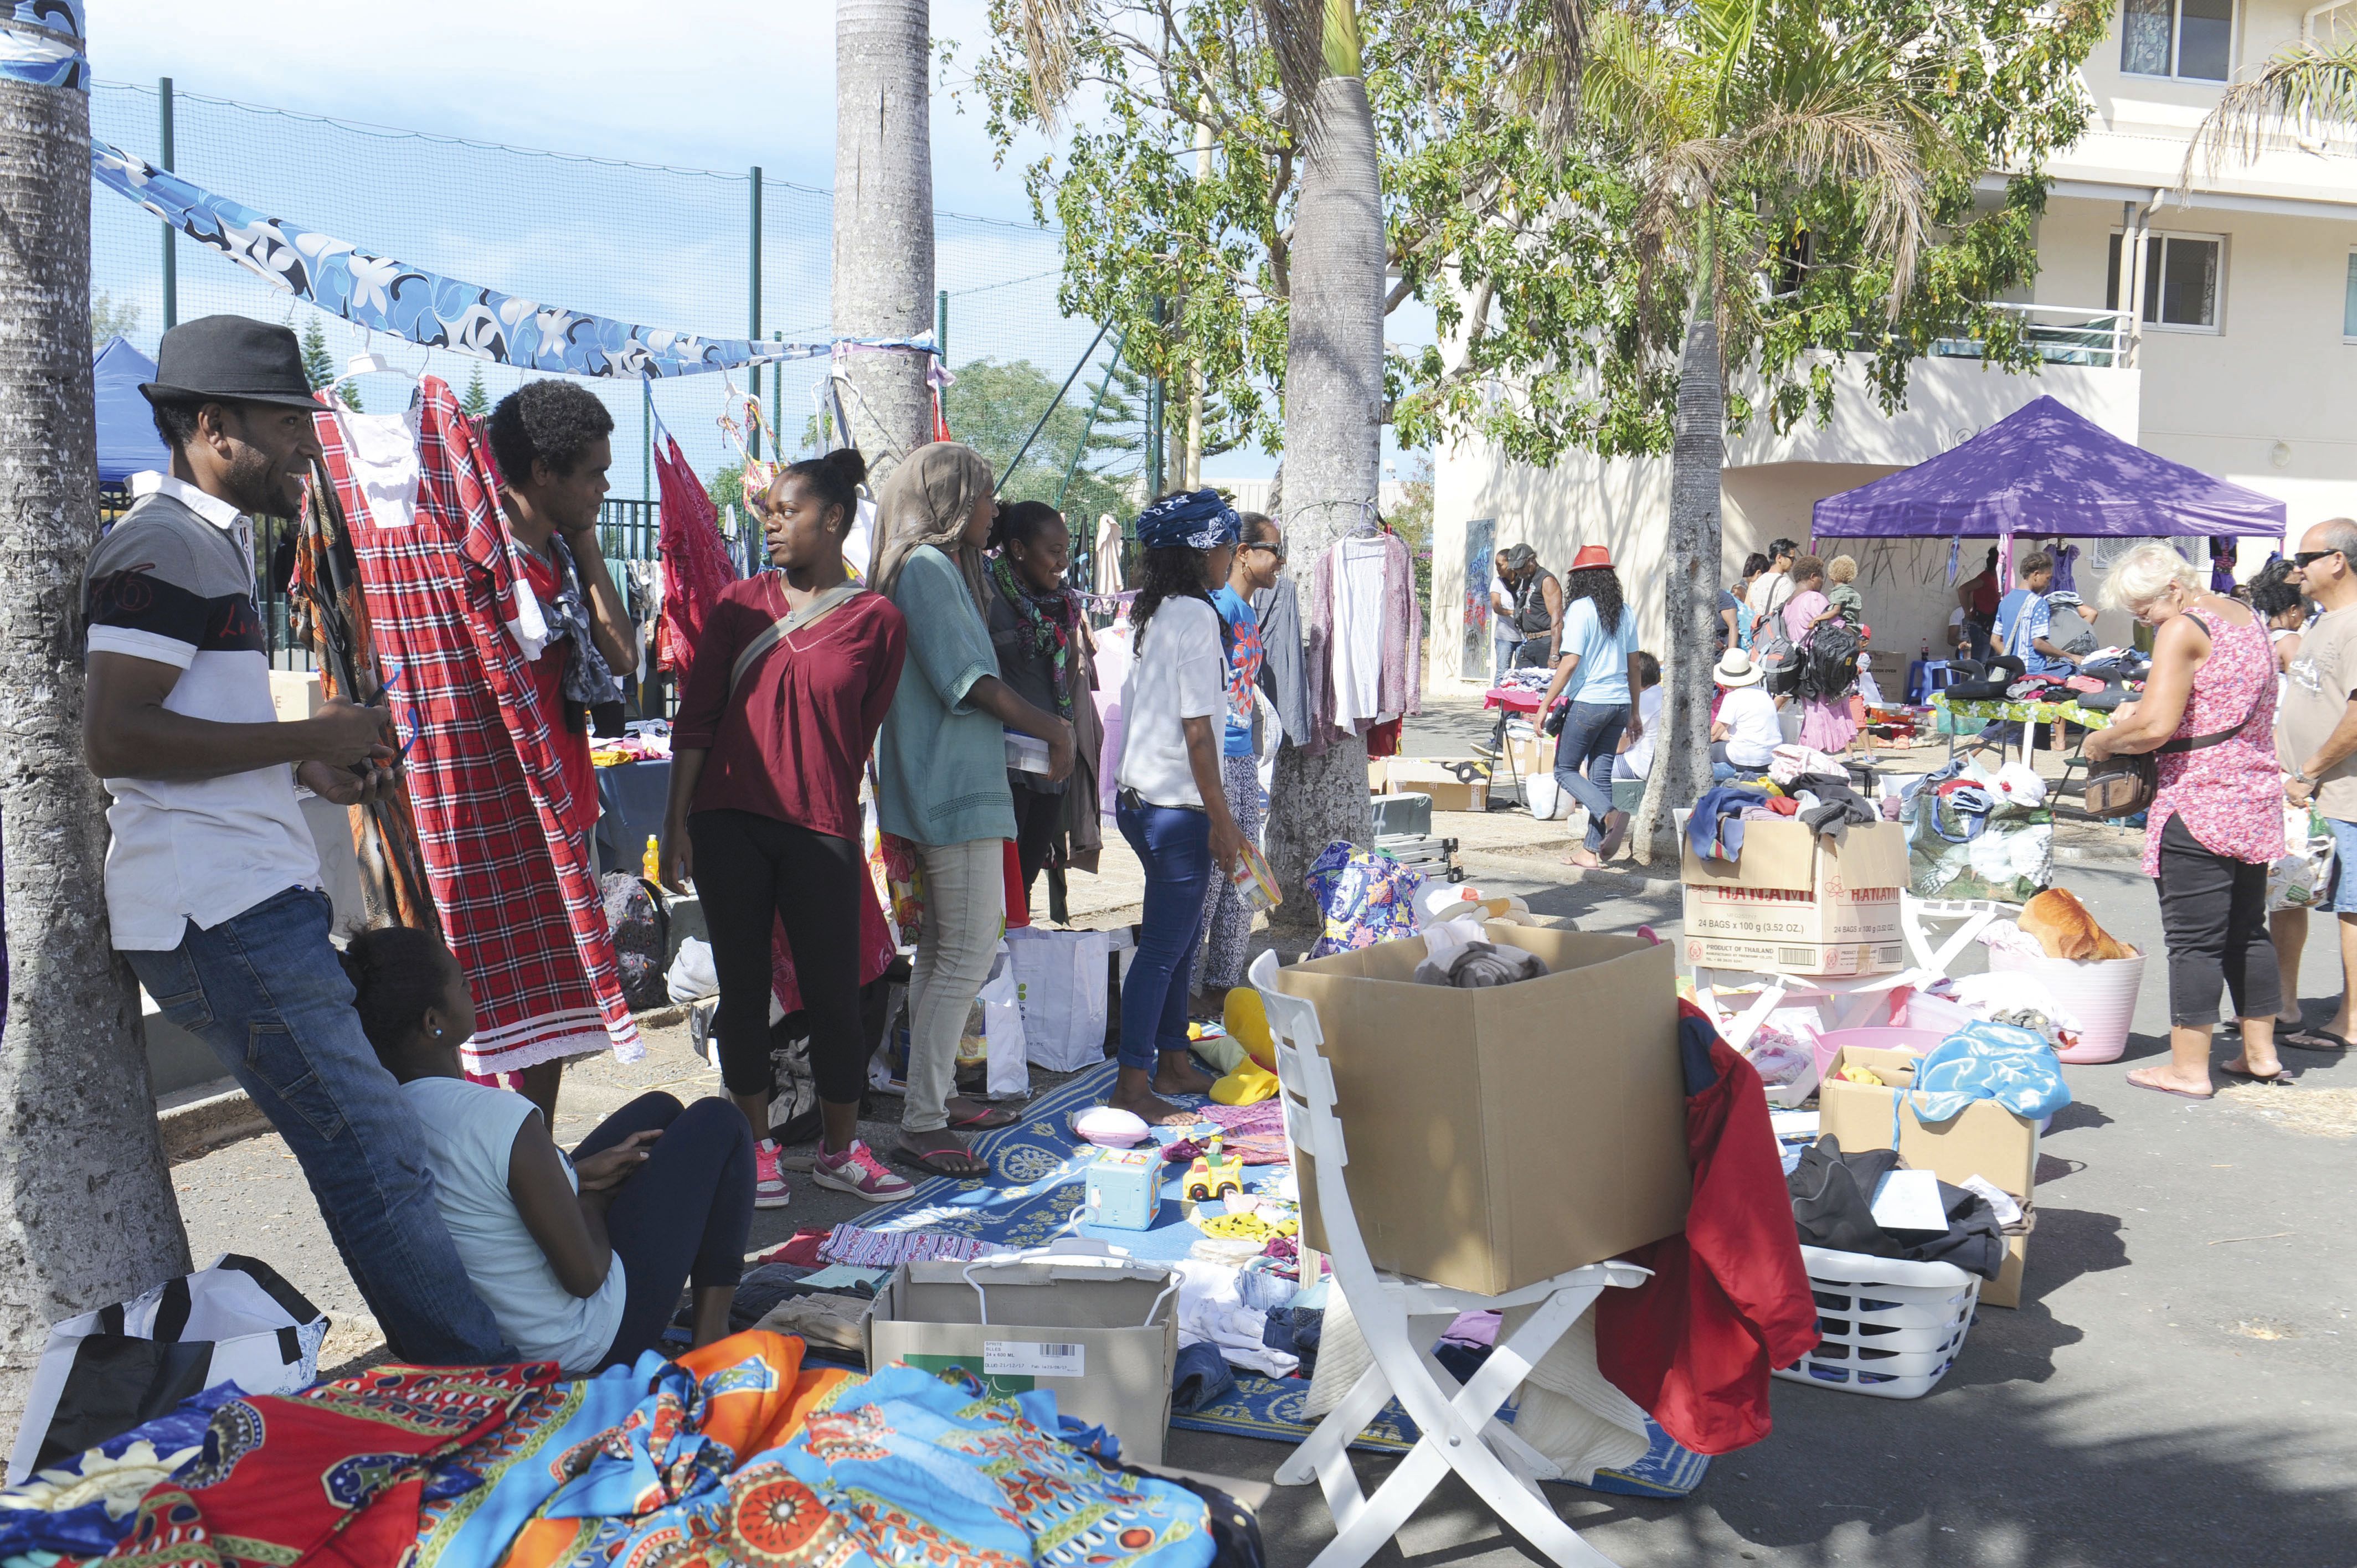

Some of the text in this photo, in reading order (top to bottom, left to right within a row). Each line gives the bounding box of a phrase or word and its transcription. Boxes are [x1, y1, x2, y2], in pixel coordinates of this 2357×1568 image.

[1709, 920, 1730, 929] BAGS
[1740, 922, 1753, 930] 100
[1756, 924, 1761, 932] g
[1763, 923, 1783, 932] (3.52
[1786, 924, 1804, 934] OZ.)
